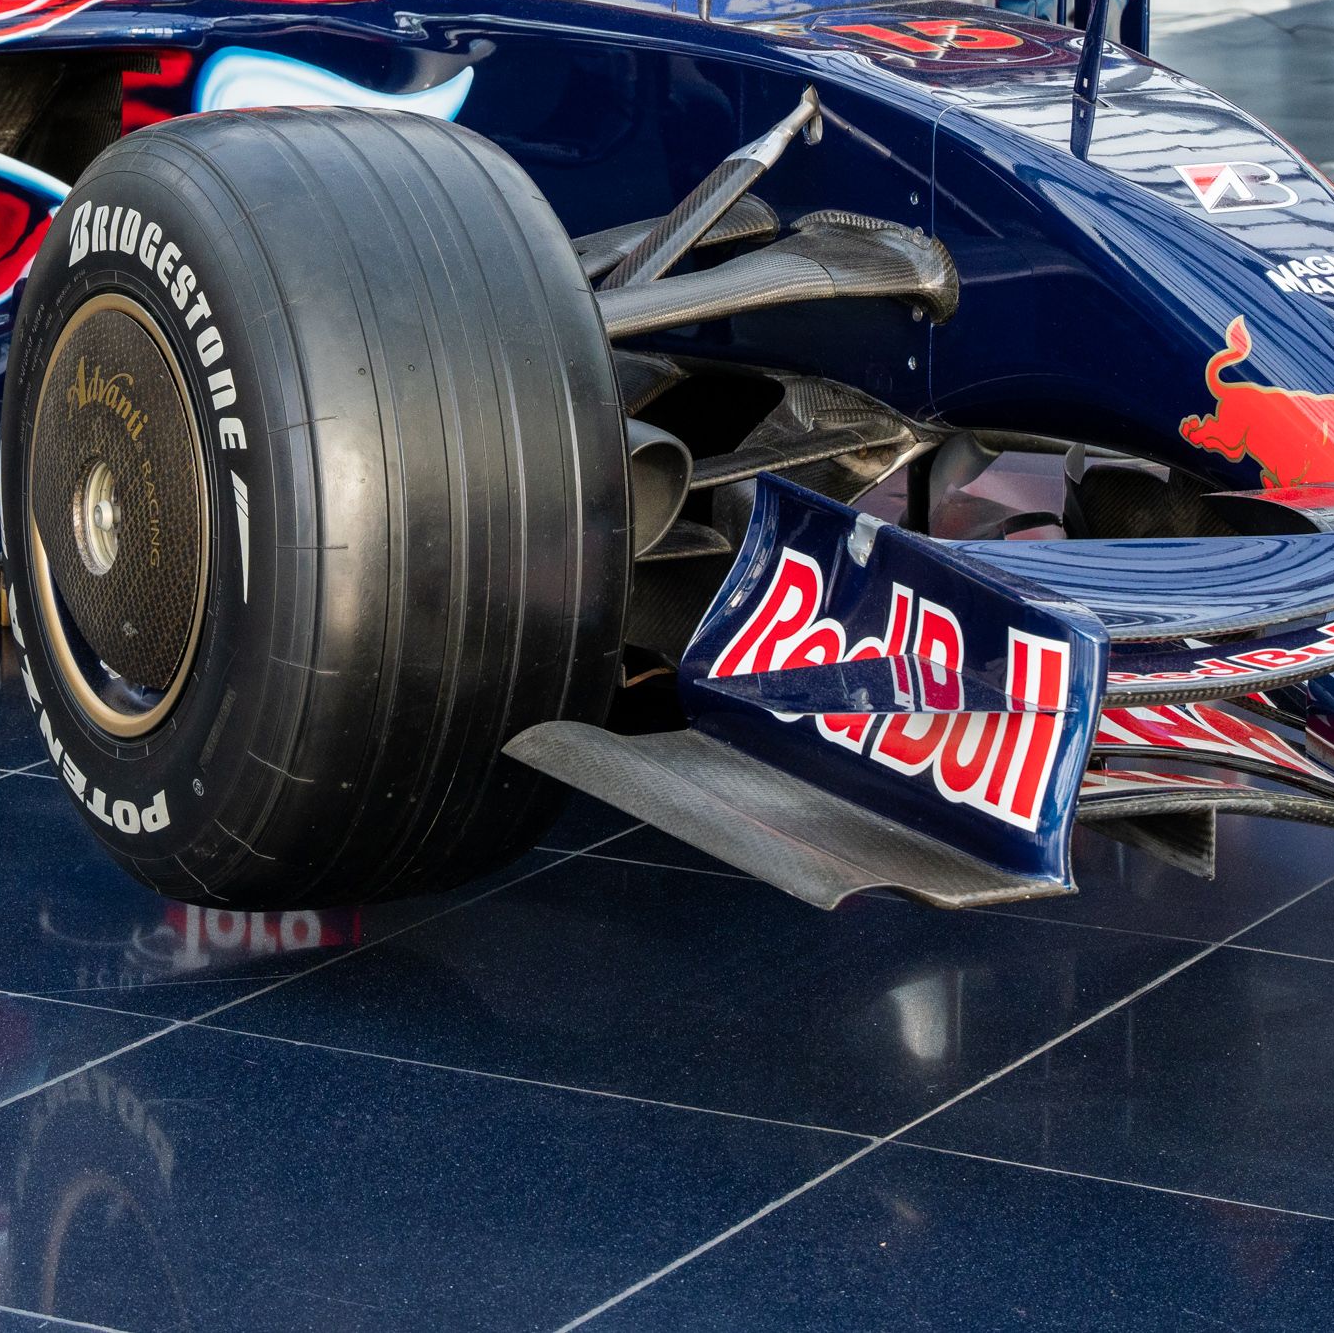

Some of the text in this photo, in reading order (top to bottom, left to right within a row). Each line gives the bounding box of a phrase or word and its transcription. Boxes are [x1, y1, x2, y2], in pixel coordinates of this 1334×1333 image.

[825, 19, 1025, 53] 15
[68, 200, 248, 450] BRIDGESTONE
[67, 356, 150, 442] Advanti
[141, 459, 161, 568] RACING
[9, 582, 171, 835] POTENZA
